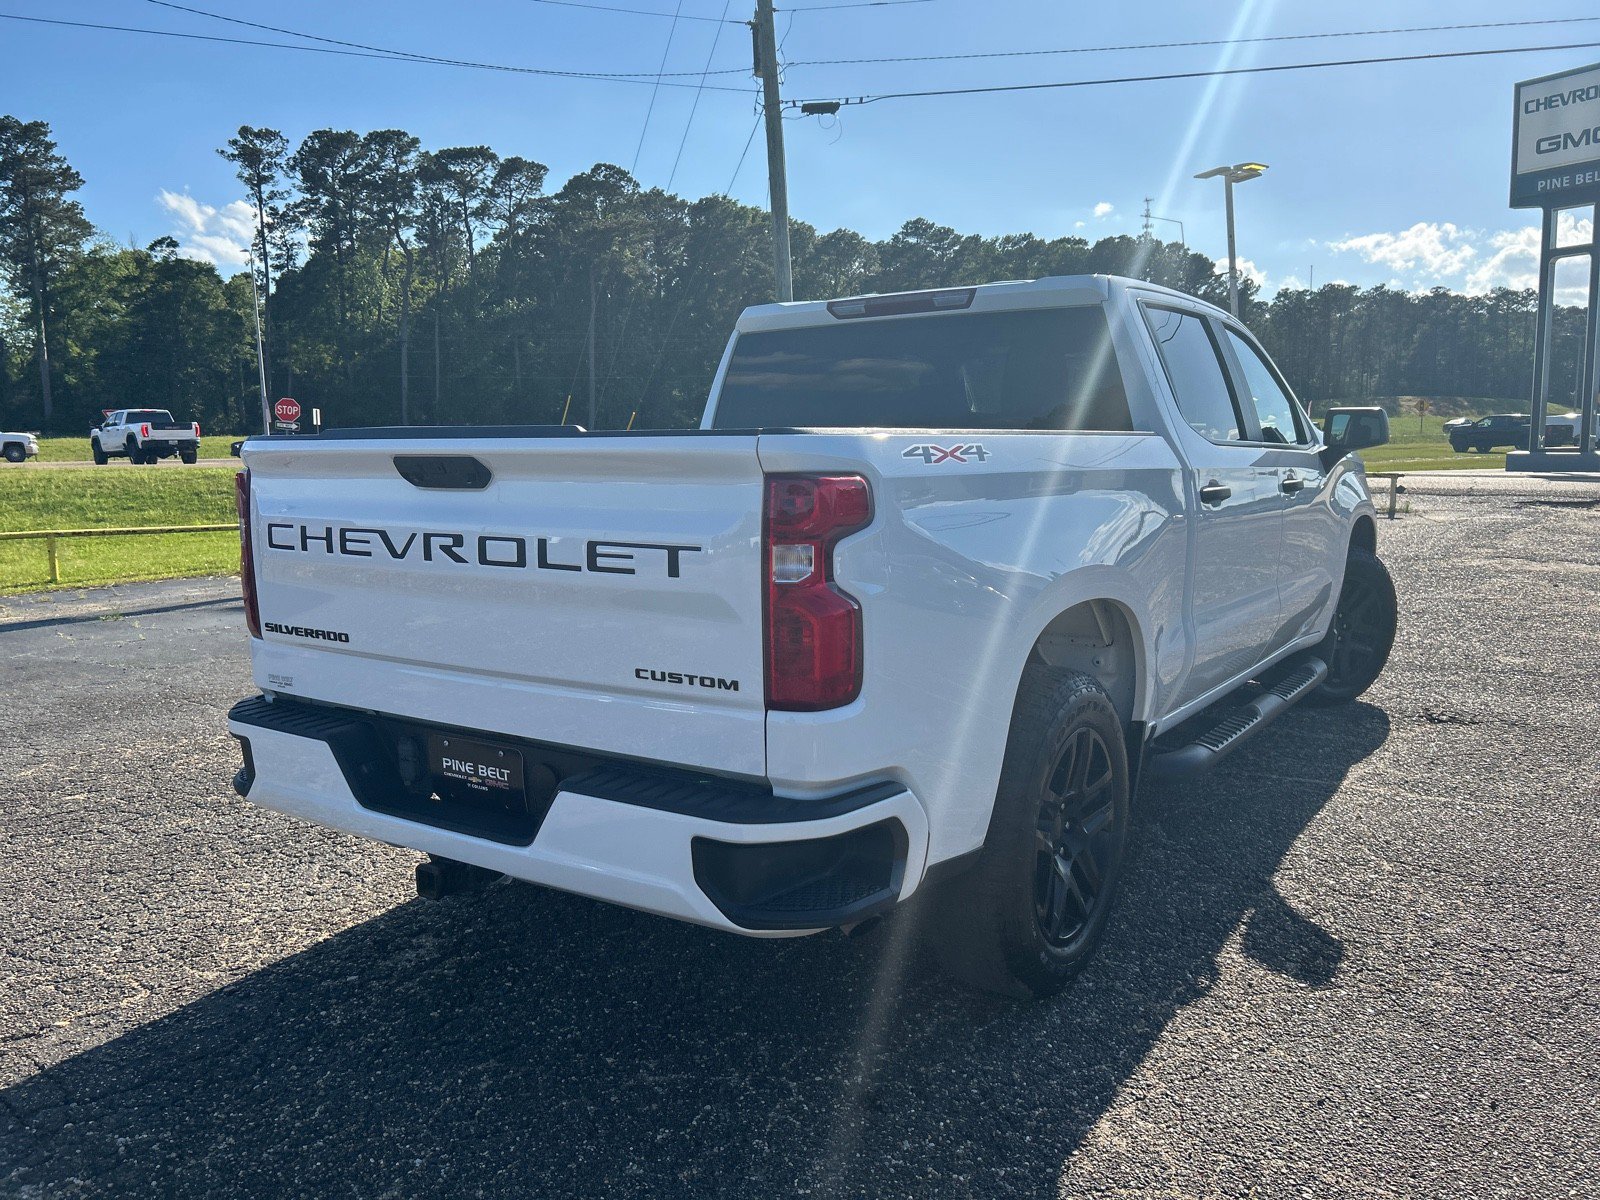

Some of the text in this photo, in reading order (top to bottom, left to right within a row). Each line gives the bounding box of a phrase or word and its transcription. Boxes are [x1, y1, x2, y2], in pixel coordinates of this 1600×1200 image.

[1525, 84, 1600, 114] CHEVRO
[1537, 175, 1570, 191] PINE
[277, 405, 299, 415] STOP
[267, 522, 702, 578] CHEVROLET
[264, 622, 350, 643] SILVERADO
[634, 668, 740, 691] CUSTOM
[442, 757, 511, 781] PINE BELT
